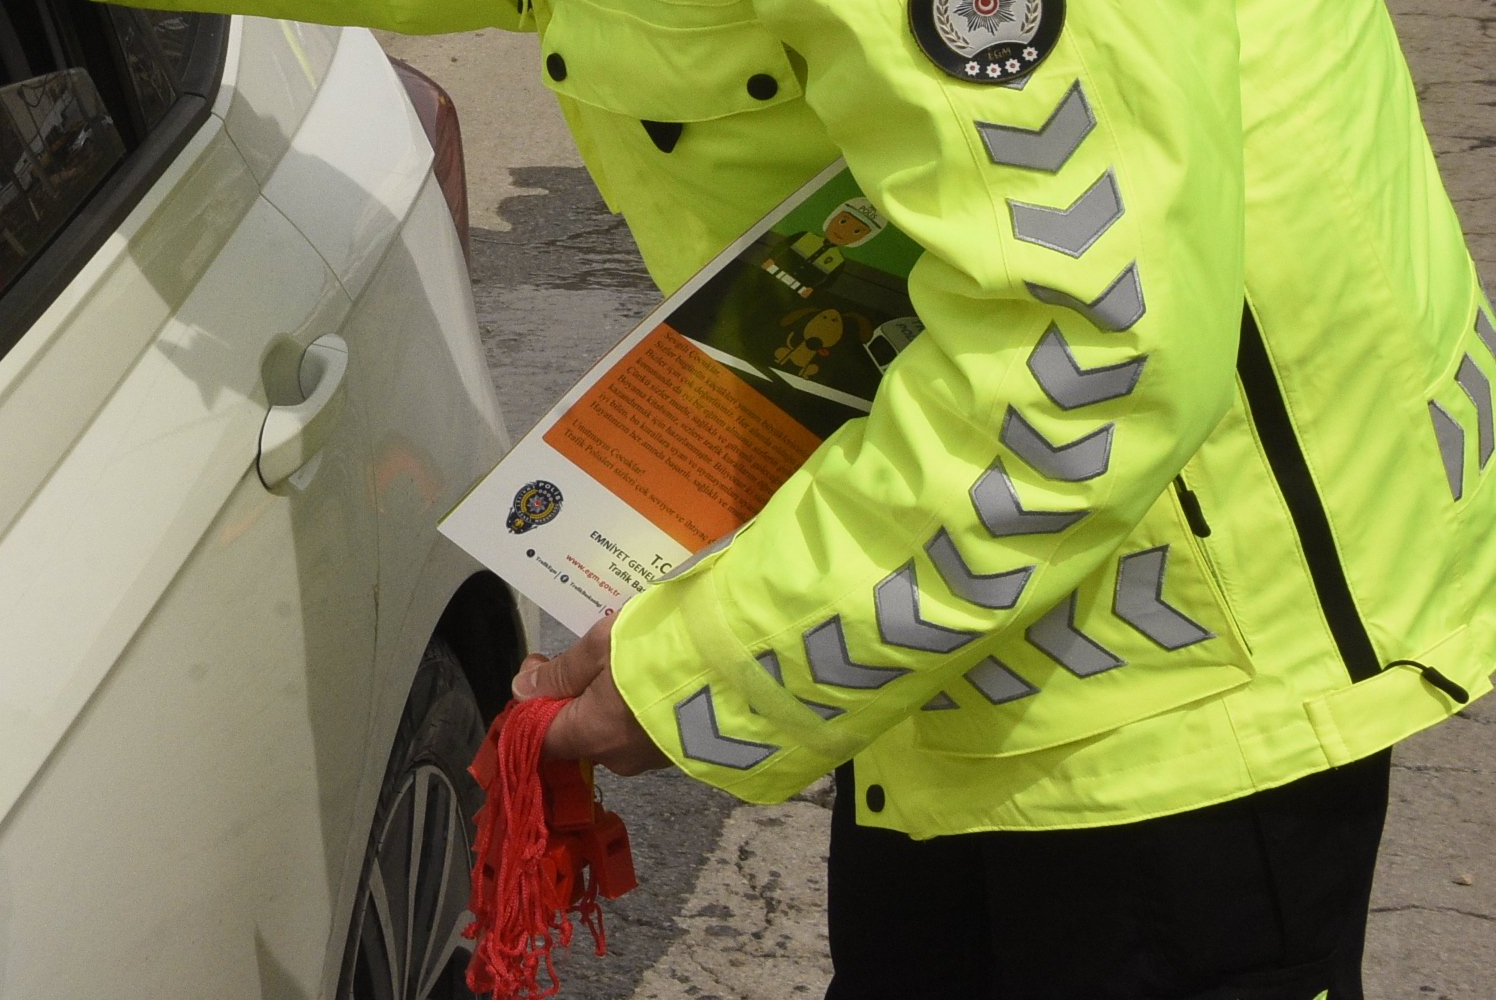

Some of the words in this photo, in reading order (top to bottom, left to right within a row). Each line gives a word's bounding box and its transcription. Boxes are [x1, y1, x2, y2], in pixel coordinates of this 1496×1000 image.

[628, 430, 643, 442] her
[716, 497, 728, 507] ve
[686, 459, 699, 469] ve
[633, 483, 650, 496] çok
[674, 513, 685, 523] ve
[588, 529, 631, 562] EMNİYET
[563, 554, 621, 598] www.egm.gov.tr
[606, 561, 634, 583] Trafik
